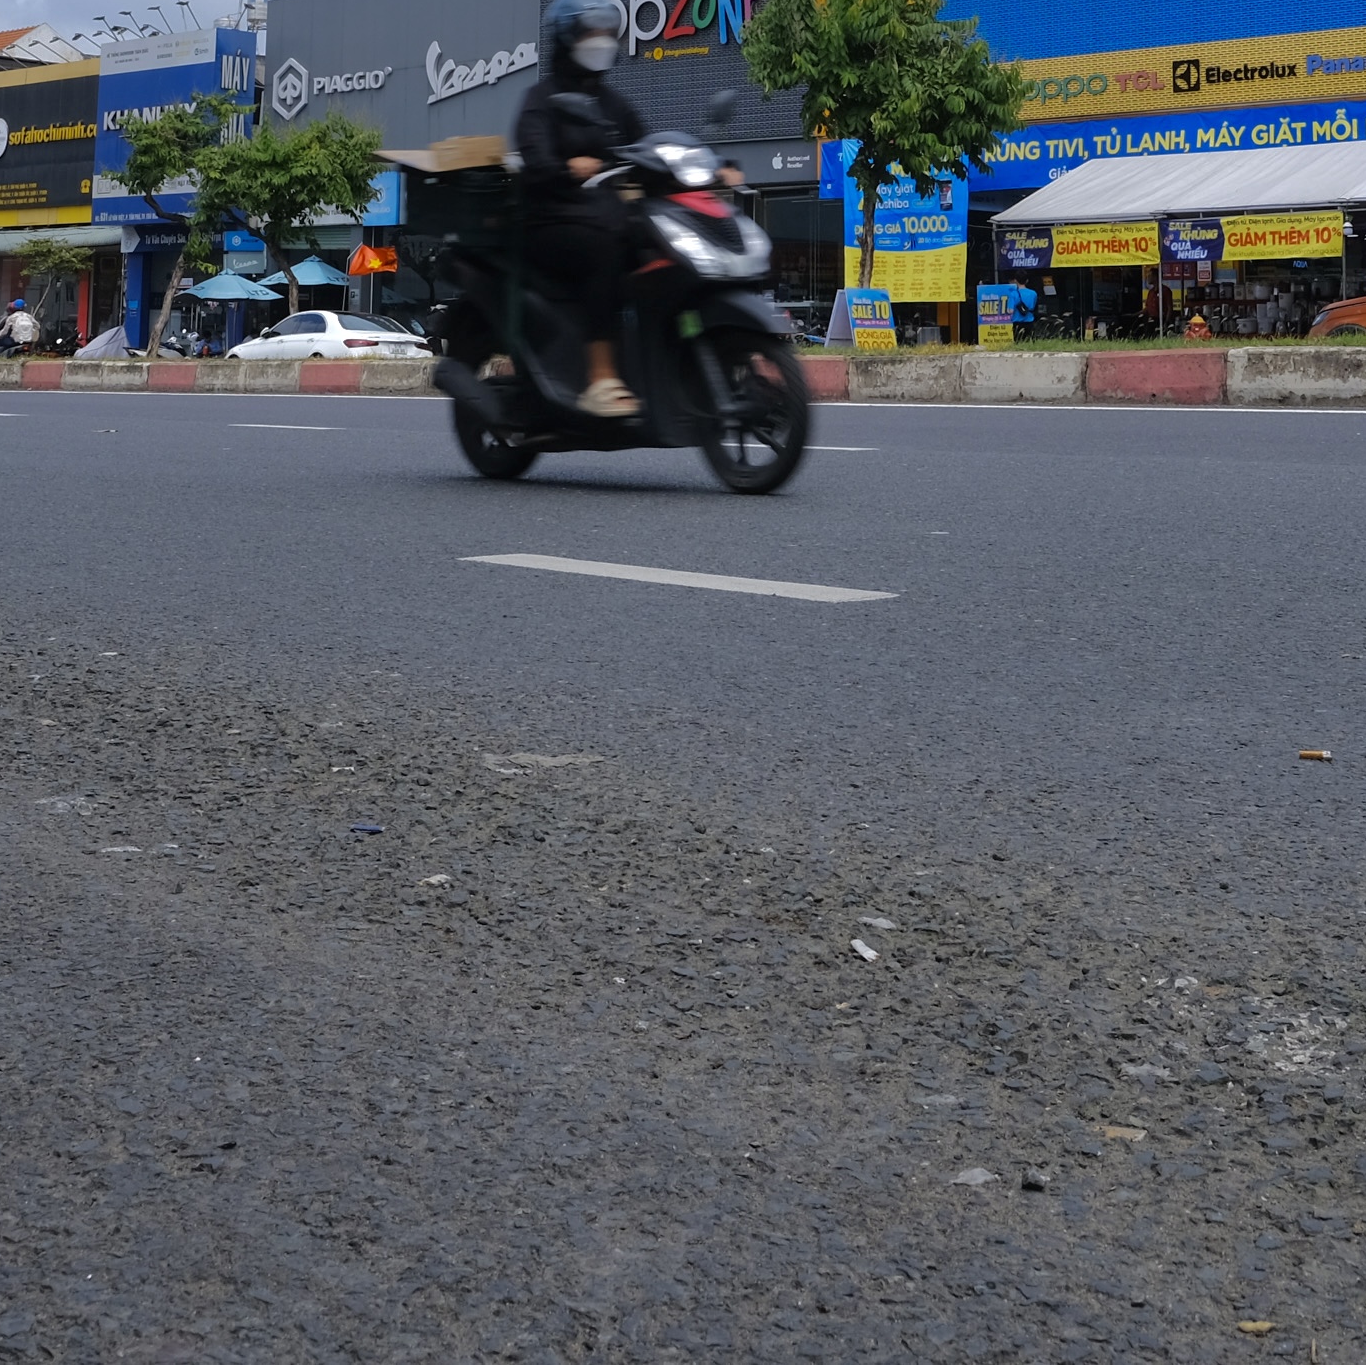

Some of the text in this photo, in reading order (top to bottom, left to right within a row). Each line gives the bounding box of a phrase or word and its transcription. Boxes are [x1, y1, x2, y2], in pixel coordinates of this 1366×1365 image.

[220, 48, 250, 91] MÁY
[313, 40, 538, 105] PIAGGIO Vespa
[1115, 71, 1165, 93] TCL
[1205, 61, 1297, 84] Electrolux
[982, 138, 1040, 163] RÚNG
[1045, 137, 1089, 160] TIVI,
[1093, 127, 1121, 155] TỦ
[1126, 130, 1190, 156] LẠNH,
[1196, 121, 1246, 148] MÁY
[1251, 117, 1307, 147] GIẶT
[1312, 108, 1358, 142] MỖI
[885, 221, 902, 234] GIÁ
[901, 214, 948, 234] 10.000
[1168, 222, 1192, 231] SALE
[1179, 226, 1218, 241] KHỦNG
[1005, 232, 1027, 241] SALE
[1015, 236, 1049, 249] KHỦNG
[1055, 236, 1157, 256] GIẢM THÊM 10%
[1171, 239, 1192, 251] QUÀ
[1227, 226, 1342, 247] GIẢM THÊM 10%
[1007, 248, 1026, 259] QUÀ
[852, 305, 873, 319] SALE
[874, 300, 890, 320] TO
[979, 300, 999, 315] SALE
